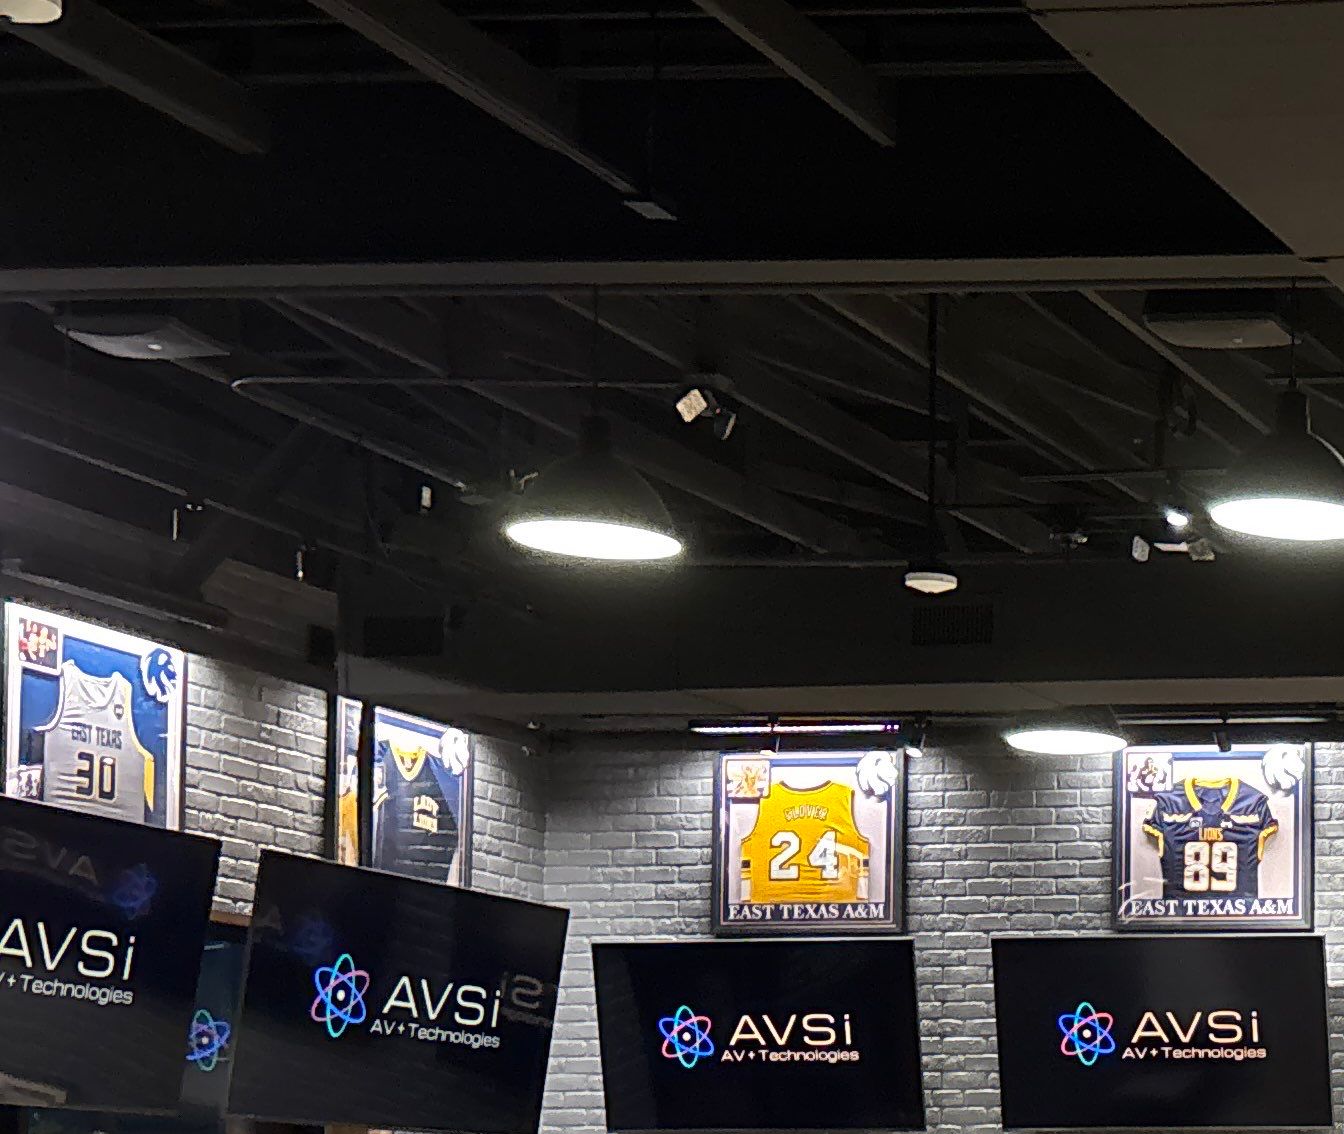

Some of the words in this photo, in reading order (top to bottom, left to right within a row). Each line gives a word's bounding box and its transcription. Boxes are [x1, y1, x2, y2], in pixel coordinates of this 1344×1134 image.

[76, 751, 116, 800] 30
[769, 829, 840, 881] 24
[1183, 841, 1238, 891] 89
[728, 904, 774, 919] EAST
[779, 904, 839, 919] TEXAS
[842, 904, 885, 919] A&M
[1131, 900, 1178, 915] EAST
[1183, 900, 1246, 915] TEXAS
[1249, 899, 1293, 914] A&M
[0, 918, 136, 981] AVSi
[382, 975, 500, 1028] AVSi
[729, 1013, 852, 1046] AVSi
[1130, 1010, 1259, 1043] AVSi
